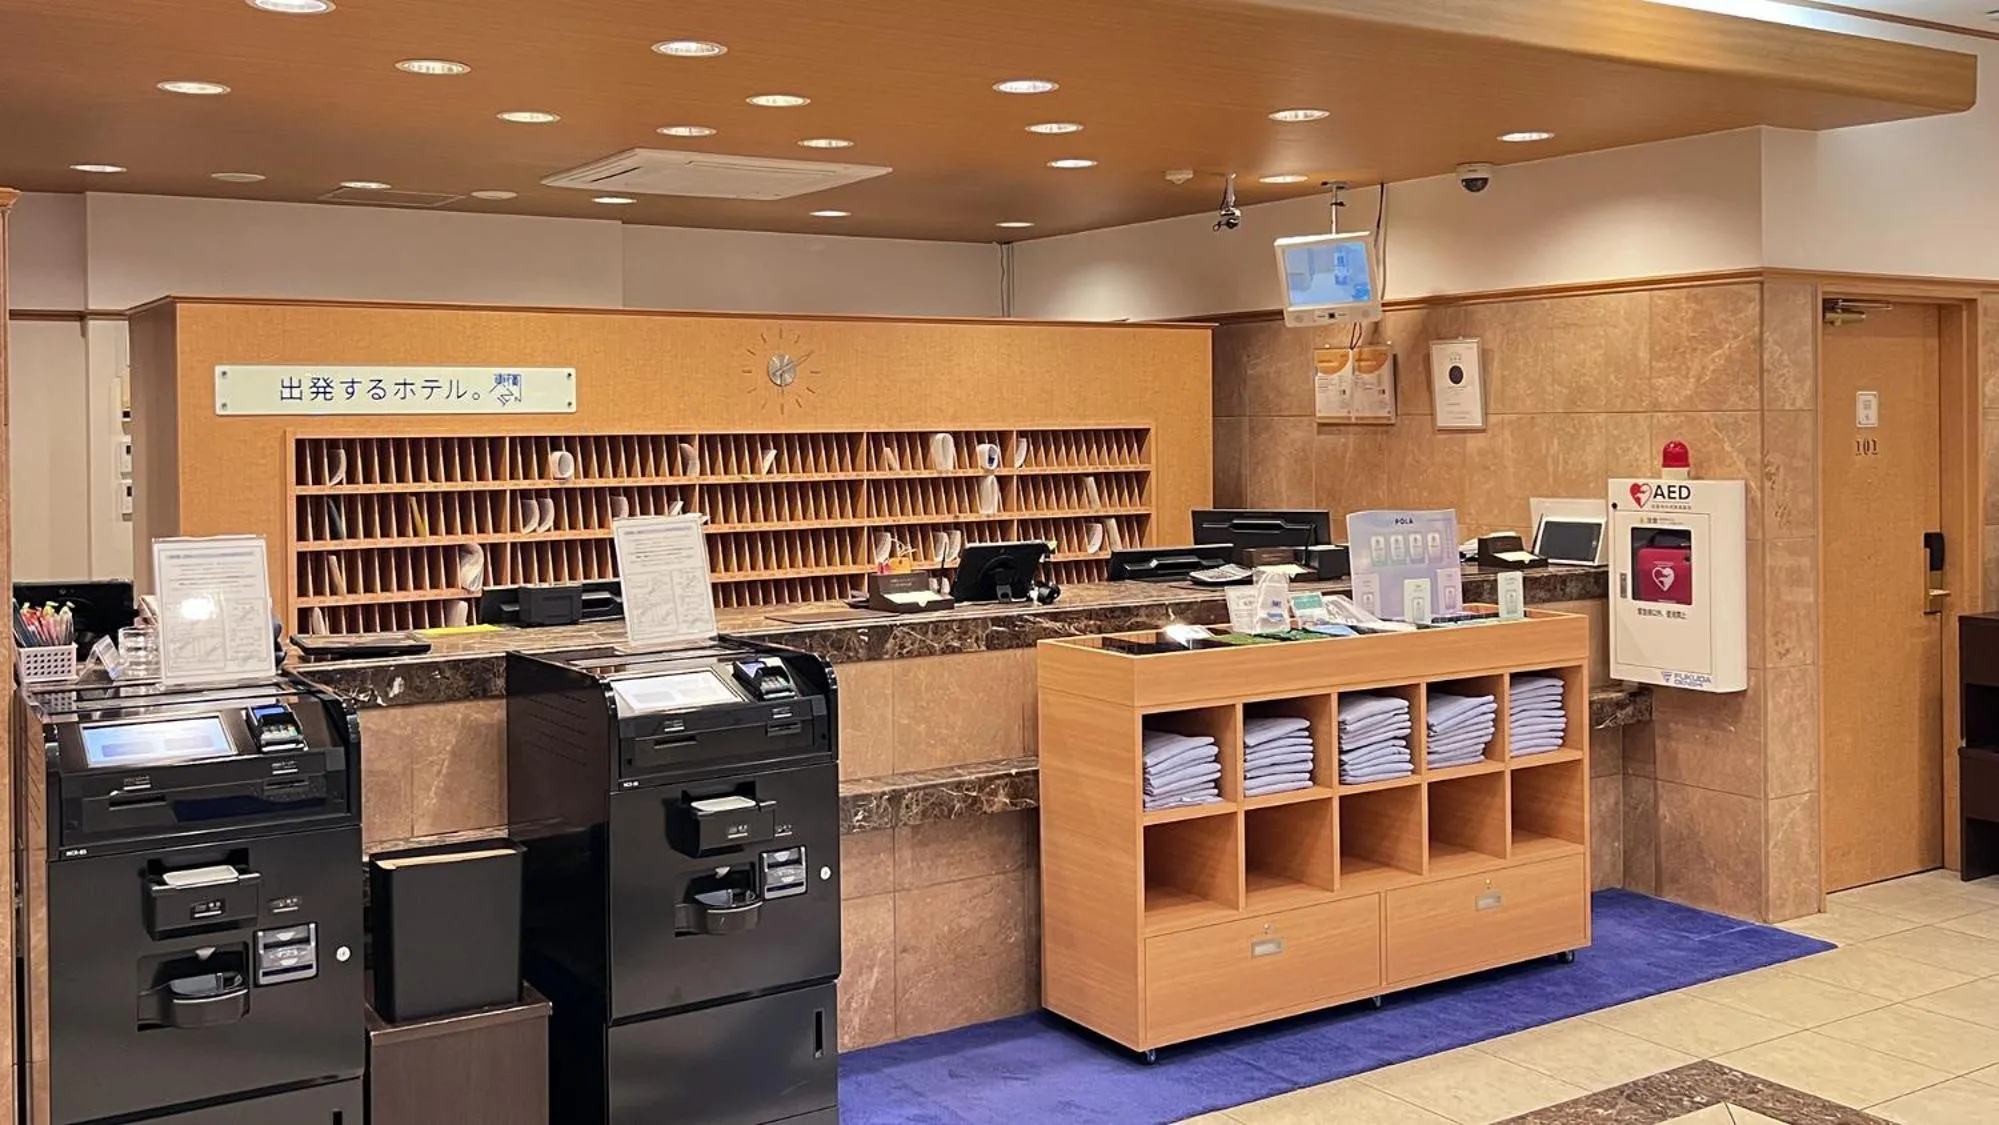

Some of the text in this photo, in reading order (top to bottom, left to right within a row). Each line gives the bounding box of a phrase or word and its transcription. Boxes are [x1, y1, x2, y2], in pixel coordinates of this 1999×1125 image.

[279, 376, 481, 401] 出発するホテル。
[1855, 439, 1878, 456] 101
[1653, 484, 1691, 500] AED
[1394, 517, 1414, 525] POLA
